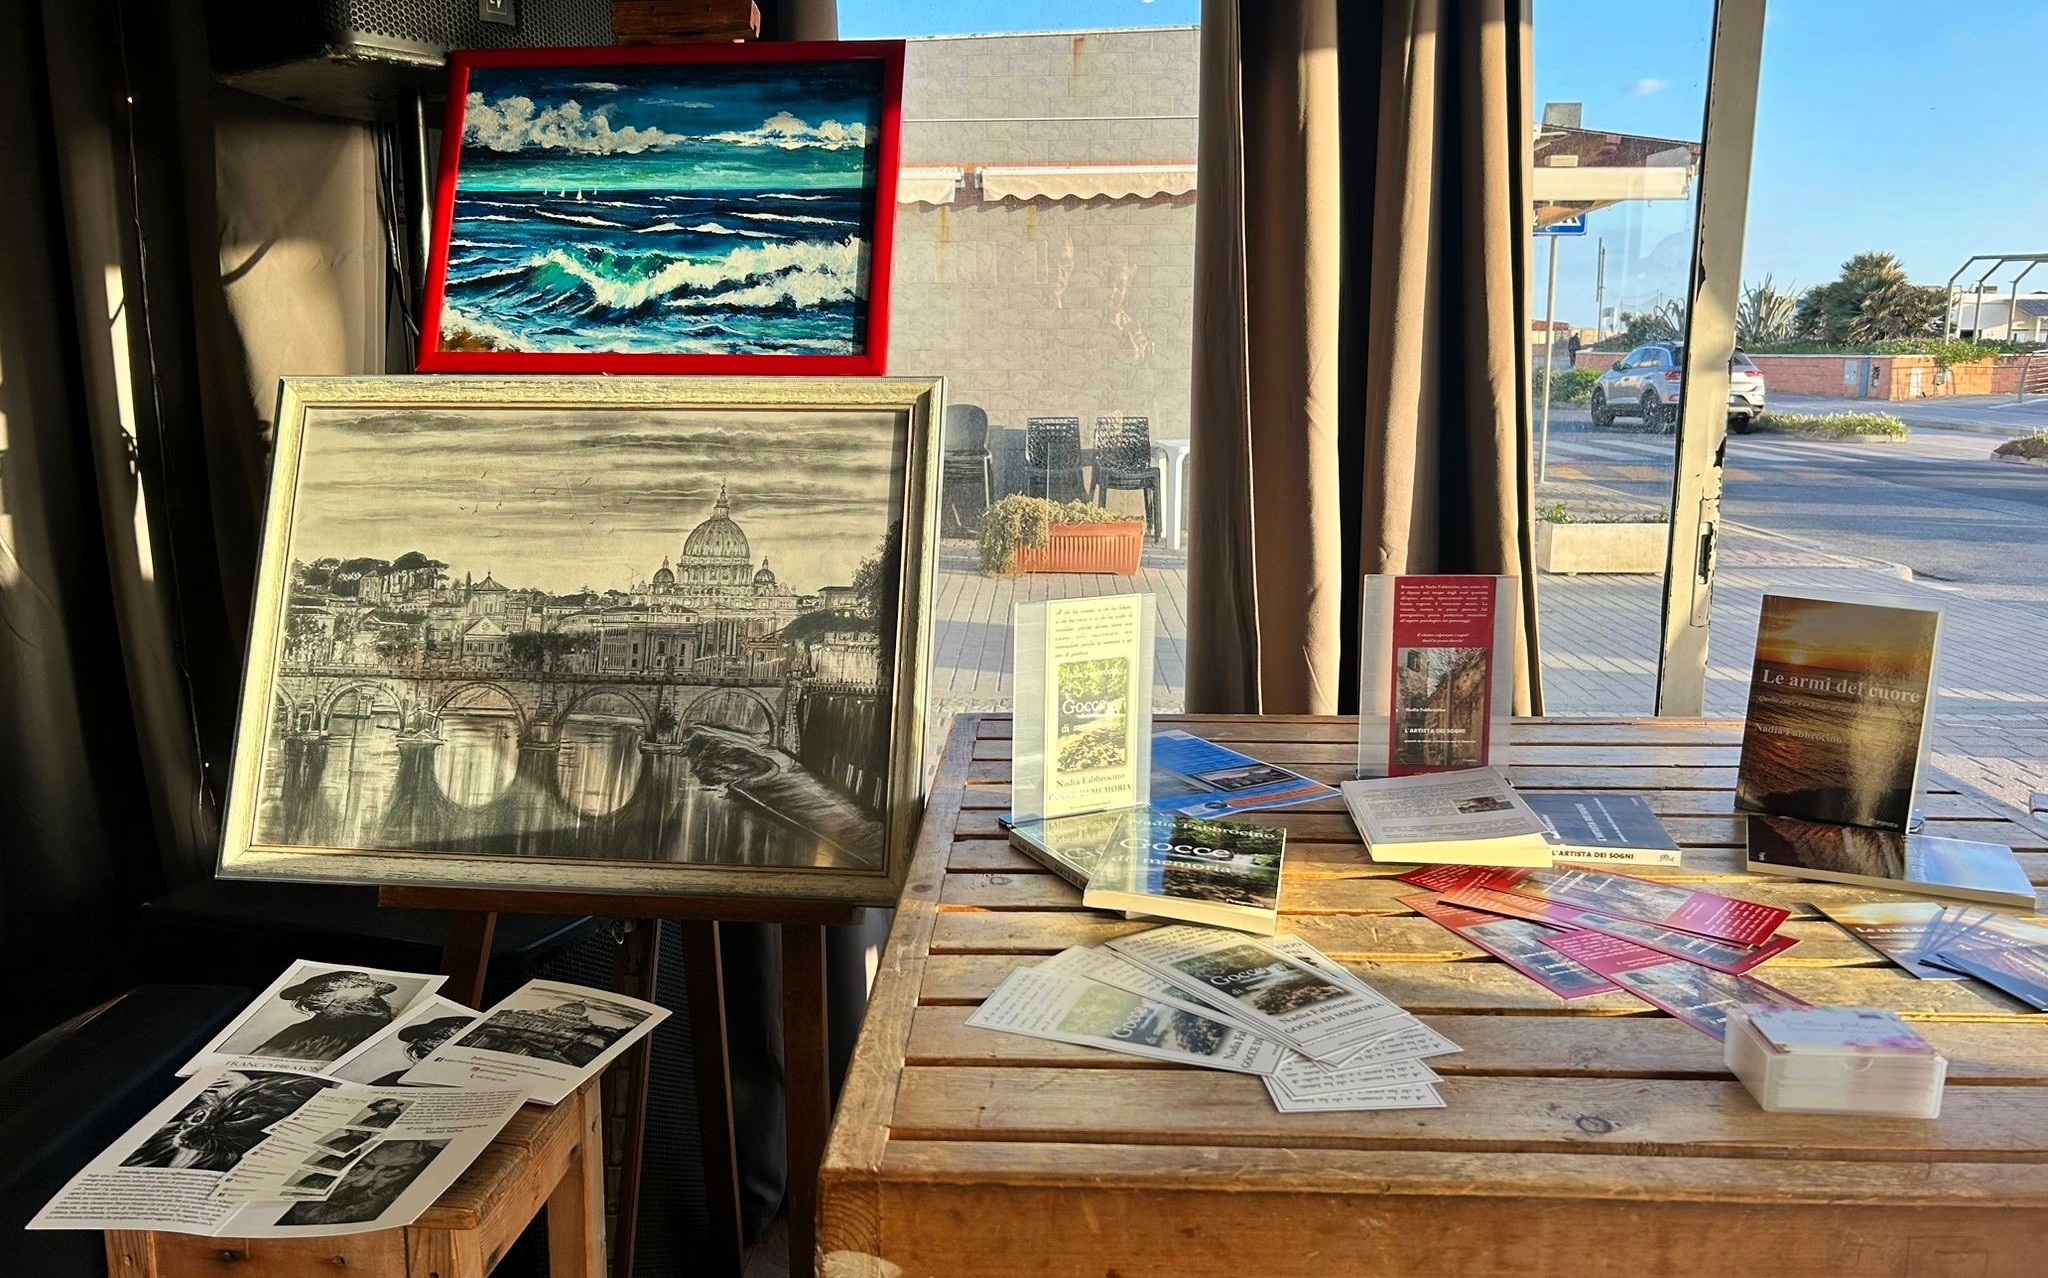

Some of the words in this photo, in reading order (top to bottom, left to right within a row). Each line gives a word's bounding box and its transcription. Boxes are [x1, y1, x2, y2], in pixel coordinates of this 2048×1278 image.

[1762, 669, 1785, 685] Le
[1789, 675, 1831, 691] armi
[1836, 680, 1864, 696] del
[1868, 686, 1921, 703] cuore
[1062, 699, 1106, 716] Gocce
[1755, 722, 1783, 735] Nadia
[1786, 727, 1842, 744] Fabbrocino
[1184, 823, 1275, 839] Fabbrocino
[1119, 837, 1231, 858] Gocce
[1552, 850, 1592, 858] L'ARTISTA
[1143, 857, 1232, 874] memoria
[1210, 967, 1266, 985] Gocce
[1278, 1012, 1311, 1024] Nadia
[1310, 998, 1364, 1015] Fabbrocino
[1284, 1019, 1322, 1034] GOCCE
[1321, 1014, 1335, 1023] DI
[1334, 1002, 1385, 1018] MEMORIA
[1111, 1006, 1147, 1038] Gocce
